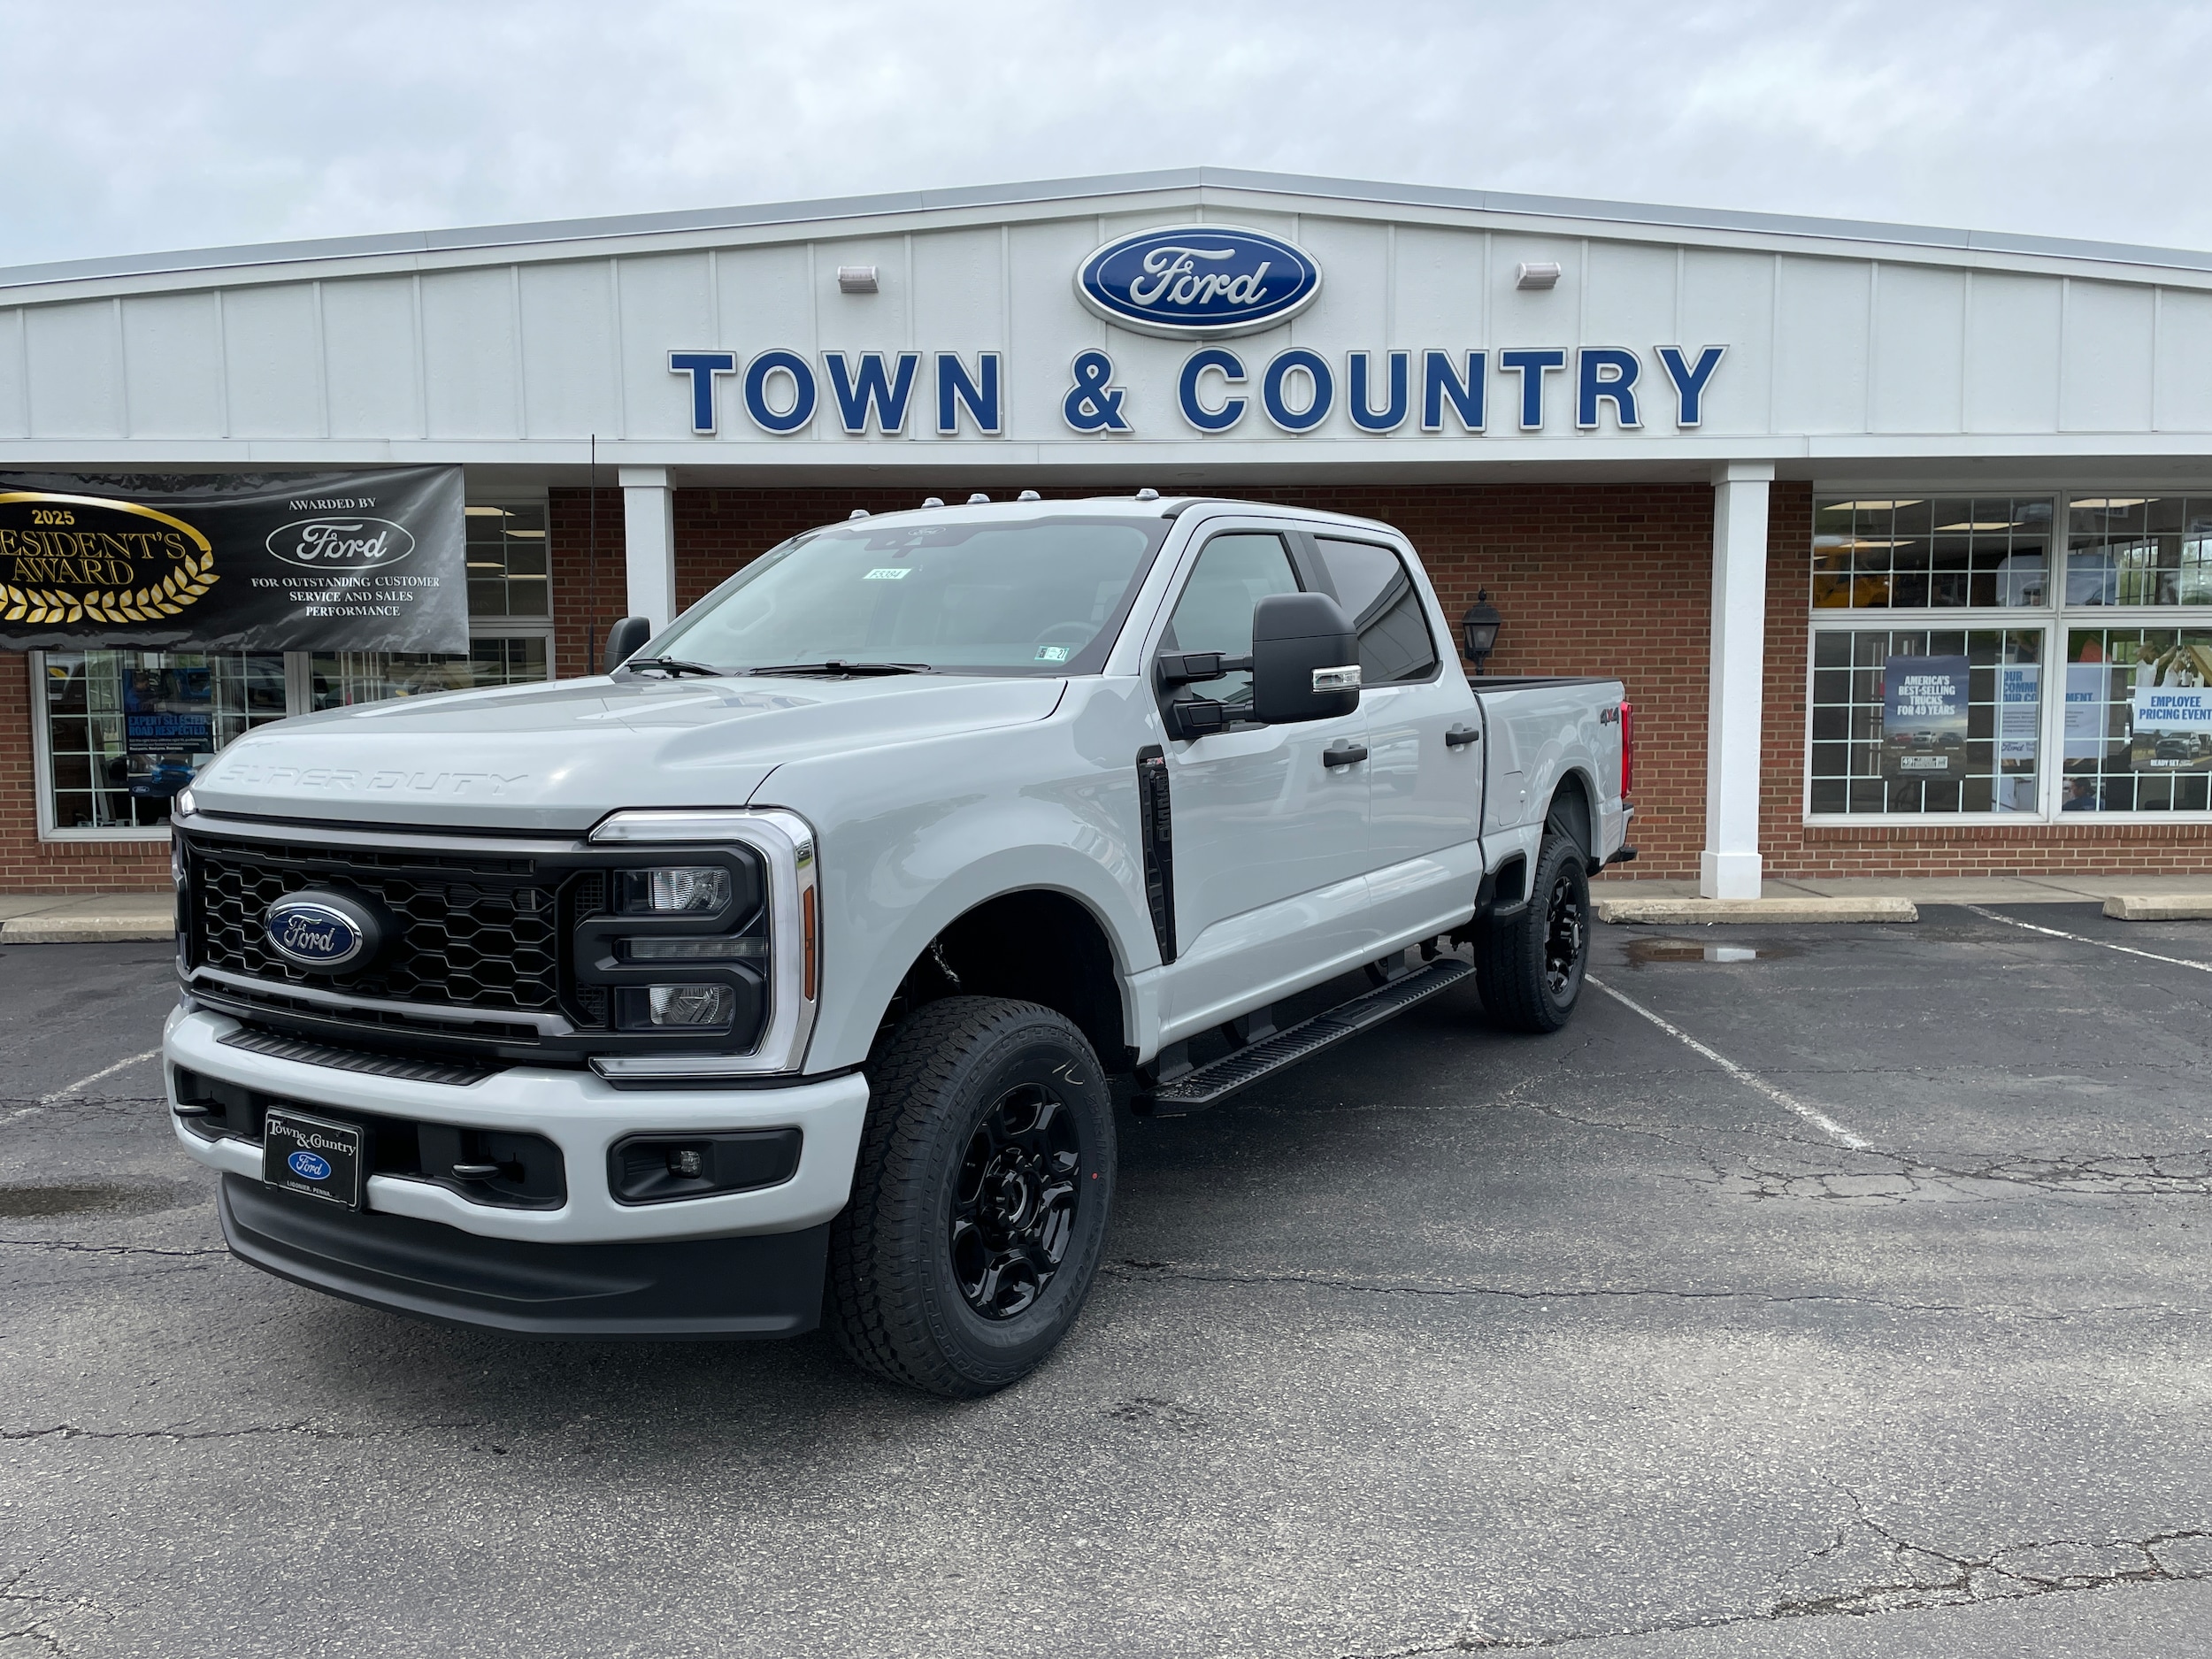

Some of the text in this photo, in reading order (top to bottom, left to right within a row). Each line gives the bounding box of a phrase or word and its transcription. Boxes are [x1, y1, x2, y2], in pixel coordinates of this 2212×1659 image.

[1130, 245, 1268, 308] Ford
[667, 343, 1730, 436] TOWN & COUNTRY
[288, 497, 377, 511] AWARDED BY
[32, 510, 75, 526] 2025
[296, 524, 388, 560] Ford
[12, 557, 134, 585] AWARD
[250, 576, 440, 588] FOR OUTSTANDING CUSTOMER
[289, 591, 413, 602] SERVICE AND SALES
[305, 605, 401, 617] PERFORMANCE
[1904, 675, 1950, 686] AMERICA'S
[1898, 686, 1956, 695] BEST-SELLING
[1909, 695, 1943, 705] TRUCKS
[2150, 695, 2201, 708] EMPLOYEE
[1897, 705, 1955, 716] FOR 49 YEARS
[2139, 709, 2212, 720] PRICING EVENT
[128, 716, 161, 726] EXPERT
[128, 726, 209, 736] ROAD RESPECTED.
[219, 764, 529, 795] SUPER DUTY
[283, 914, 335, 952] Ford
[296, 1154, 323, 1176] Ford
